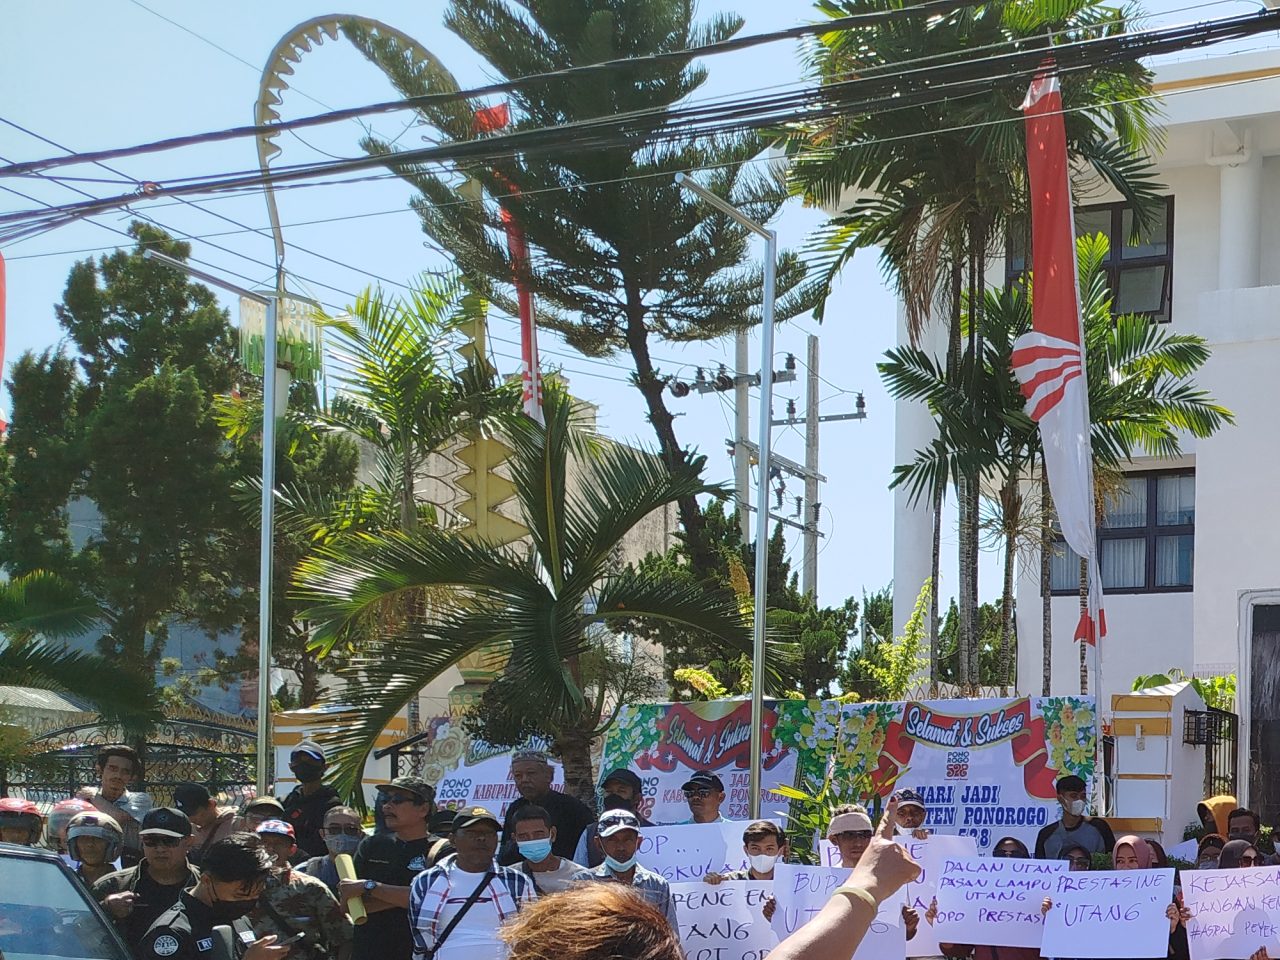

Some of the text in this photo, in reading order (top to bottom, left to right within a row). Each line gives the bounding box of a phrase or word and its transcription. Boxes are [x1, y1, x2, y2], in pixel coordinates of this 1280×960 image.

[905, 706, 1025, 748] Selamat & Sukses
[443, 778, 472, 788] PONO
[472, 783, 519, 800] KABUPATE
[439, 788, 469, 798] ROGO
[961, 785, 999, 804] JADI
[963, 806, 1047, 826] PONOROGO
[943, 860, 1004, 875] DALAN
[995, 879, 1052, 891] LAMPU
[1056, 874, 1166, 893] PRESTASINE
[965, 890, 1026, 902] UTANG
[1189, 896, 1256, 918] JANGAN
